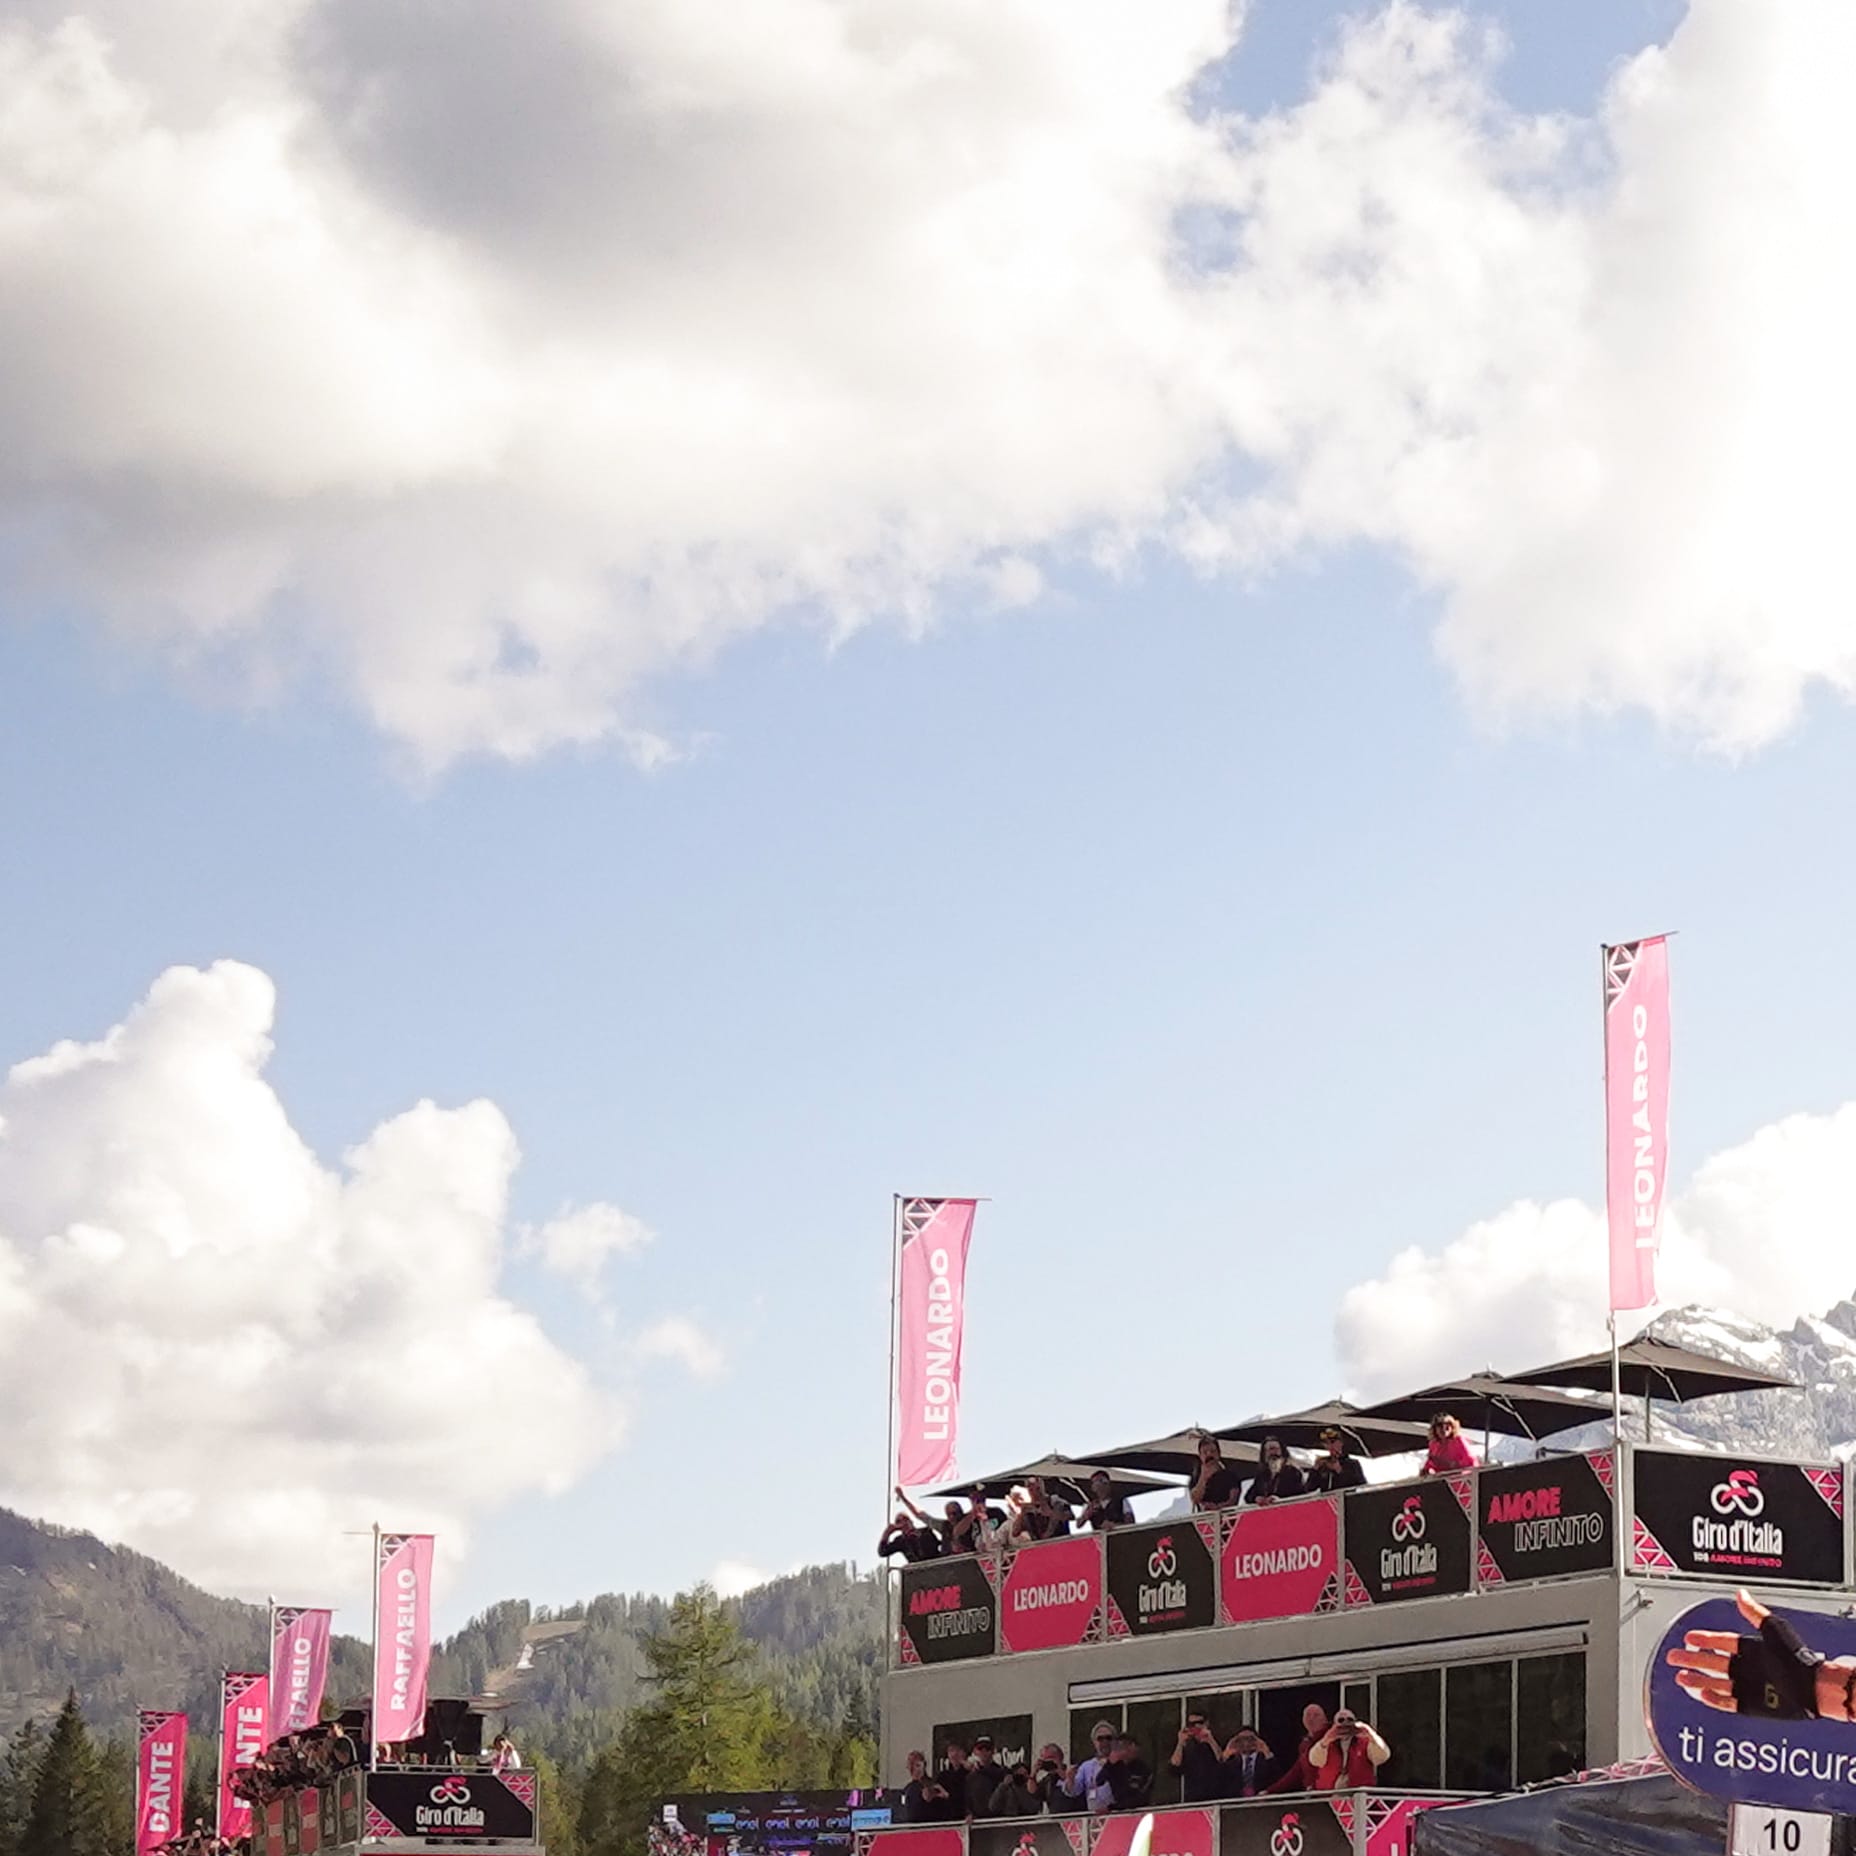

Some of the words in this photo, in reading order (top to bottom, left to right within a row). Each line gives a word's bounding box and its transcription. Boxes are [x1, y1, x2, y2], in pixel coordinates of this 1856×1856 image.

[1632, 1004, 1658, 1250] LEONARDO
[922, 1248, 951, 1441] LEONARDO
[1487, 1486, 1561, 1523] AMORE
[1514, 1513, 1604, 1552] INFINITO
[1692, 1515, 1727, 1549] Giro
[1729, 1519, 1783, 1555] d'Italia
[1235, 1544, 1322, 1580] LEONARDO
[1014, 1579, 1089, 1612] LEONARDO
[391, 1568, 417, 1710] RAFFAELLO
[1678, 1725, 1704, 1763] ti
[150, 1741, 174, 1833] DANTE
[416, 1806, 442, 1826] Giro
[1763, 1818, 1801, 1852] 10
